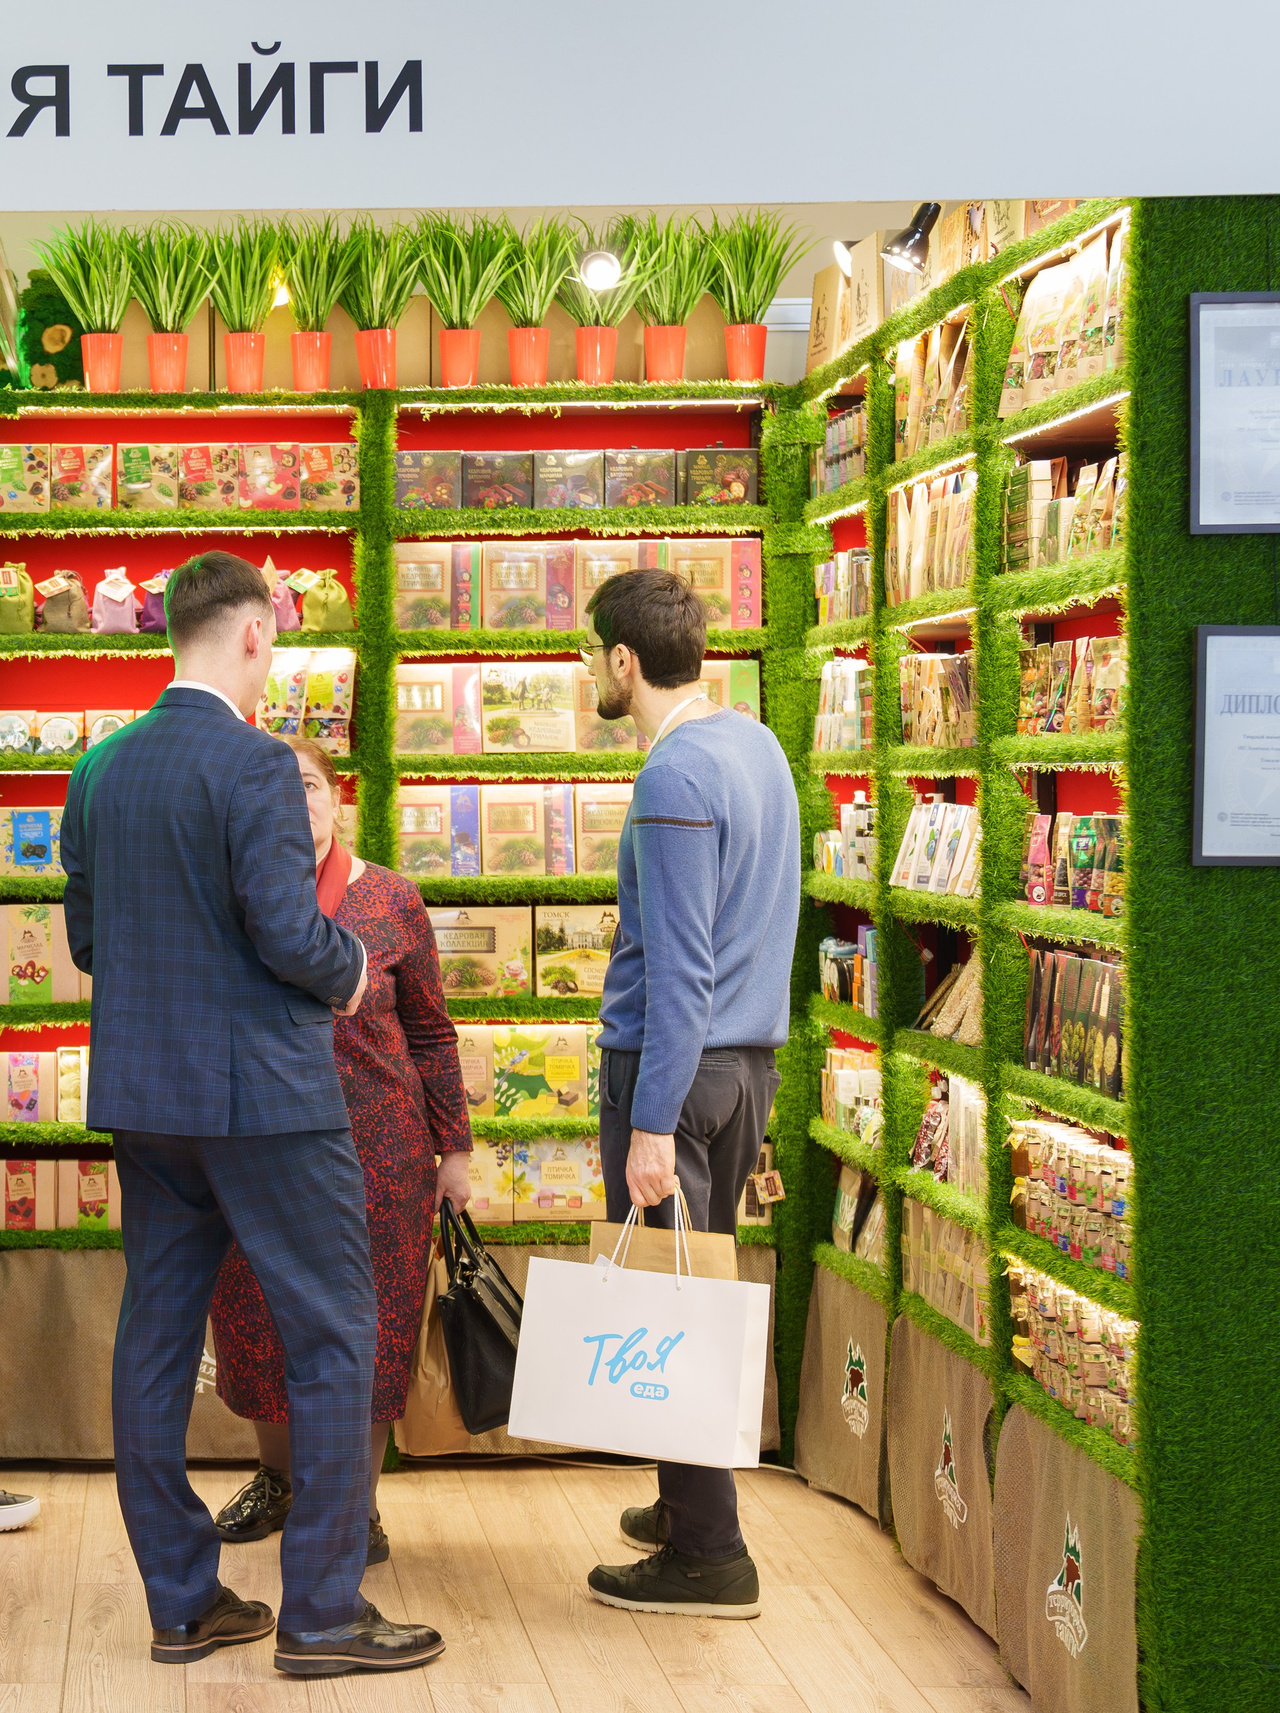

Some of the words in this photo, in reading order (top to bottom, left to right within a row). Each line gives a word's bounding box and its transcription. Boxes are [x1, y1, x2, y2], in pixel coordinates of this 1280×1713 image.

[106, 41, 423, 137] ТАЙГИ
[542, 911, 570, 919] ТОМСК
[443, 932, 486, 940] КЕДРОВАЯ
[440, 940, 488, 949] КОЛЛЕКЦИЯ
[583, 1327, 686, 1386] Твоя
[633, 1382, 665, 1399] еда
